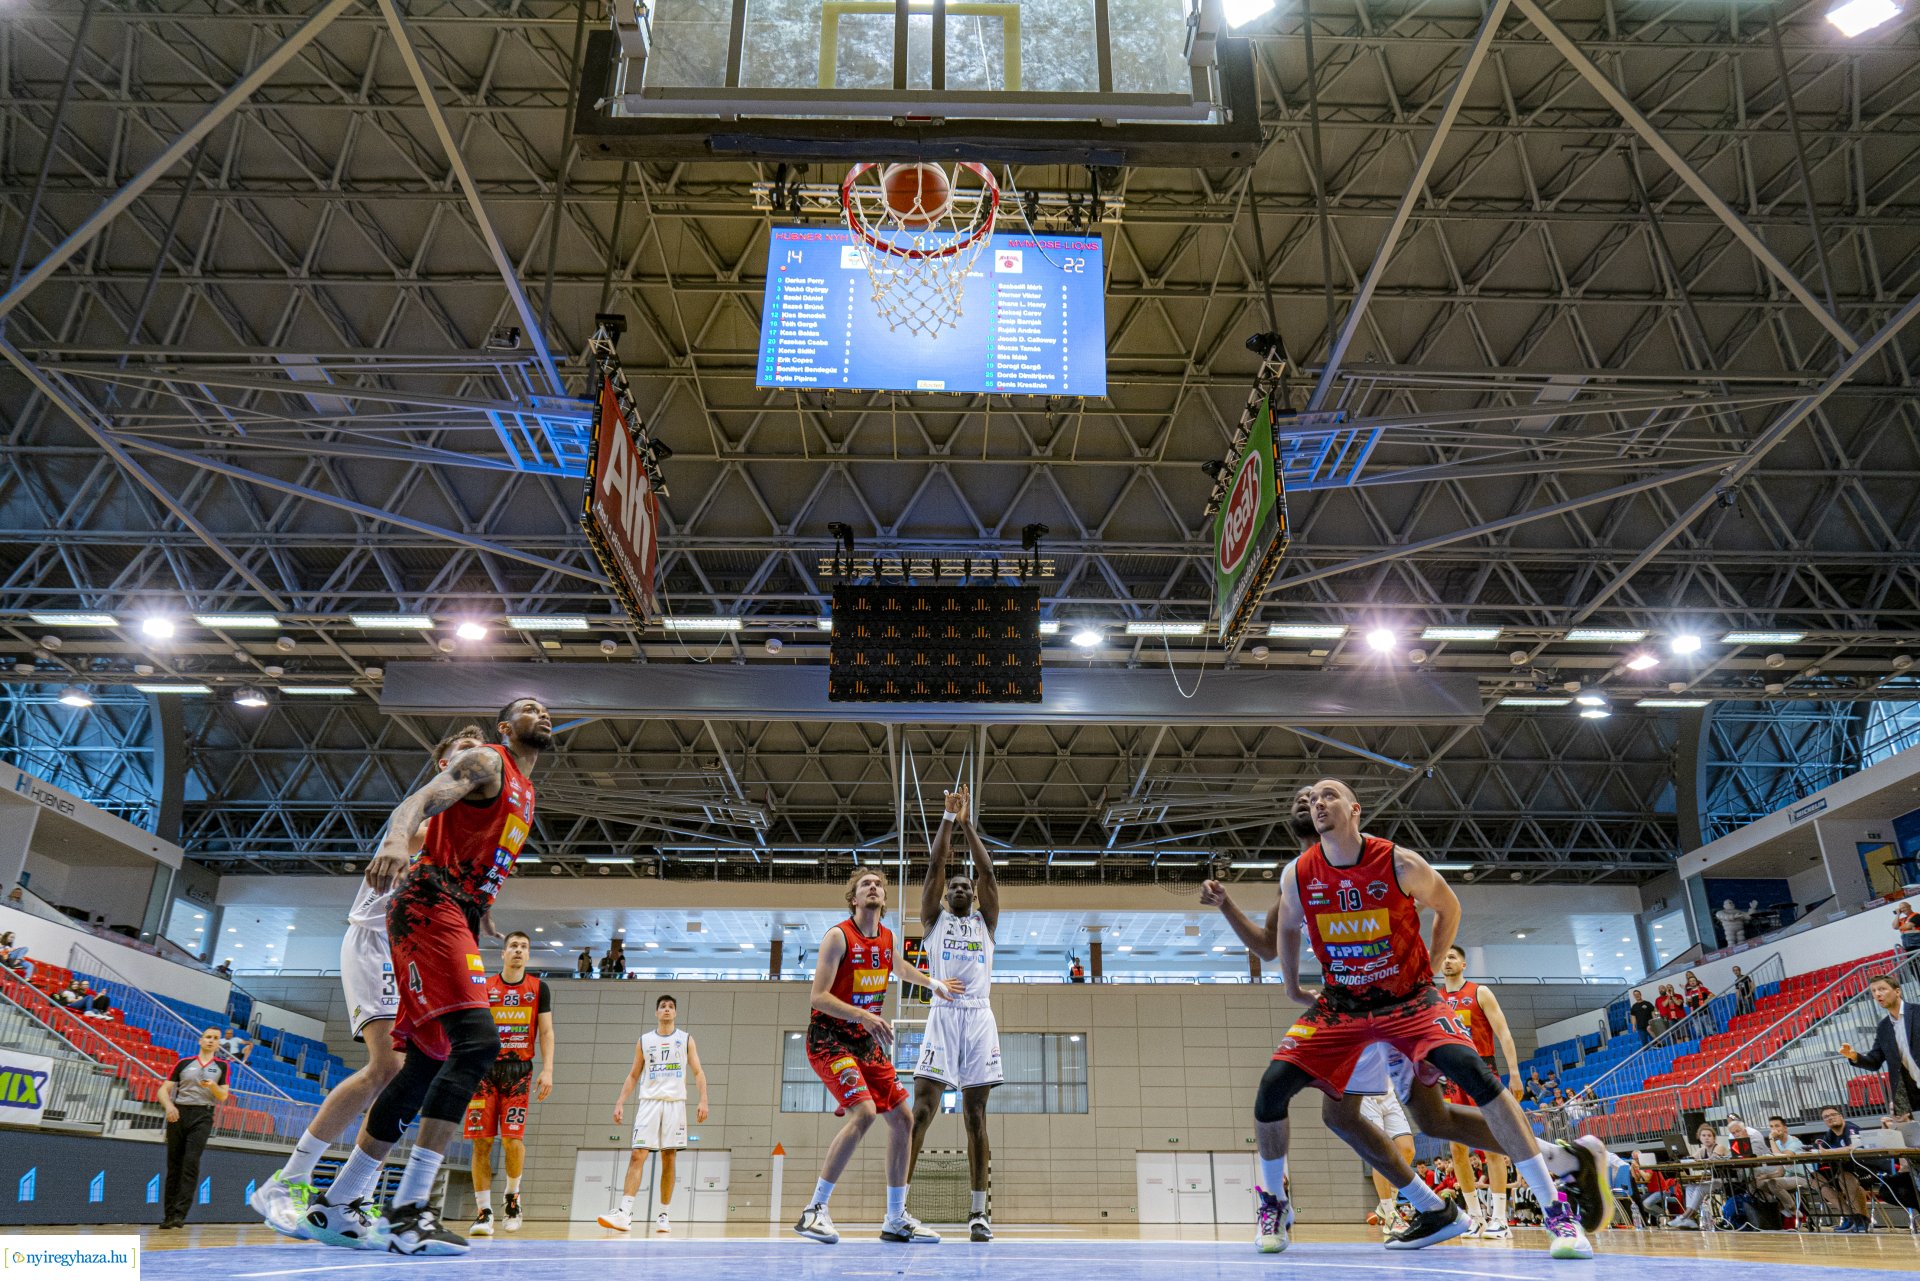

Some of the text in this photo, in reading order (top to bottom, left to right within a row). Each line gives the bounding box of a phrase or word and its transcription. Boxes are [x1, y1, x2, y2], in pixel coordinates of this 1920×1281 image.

[787, 250, 802, 264] 14
[1064, 258, 1085, 273] 22
[1336, 888, 1362, 912] 19
[1330, 918, 1380, 935] MVM
[872, 953, 880, 968] 5
[382, 972, 395, 996] 3
[408, 961, 422, 993] 4
[861, 976, 886, 986] MVM
[504, 994, 519, 1006] 25
[496, 1011, 526, 1019] MVM
[661, 1050, 670, 1061] 17
[922, 1049, 935, 1065] 21
[505, 1107, 526, 1124] 25
